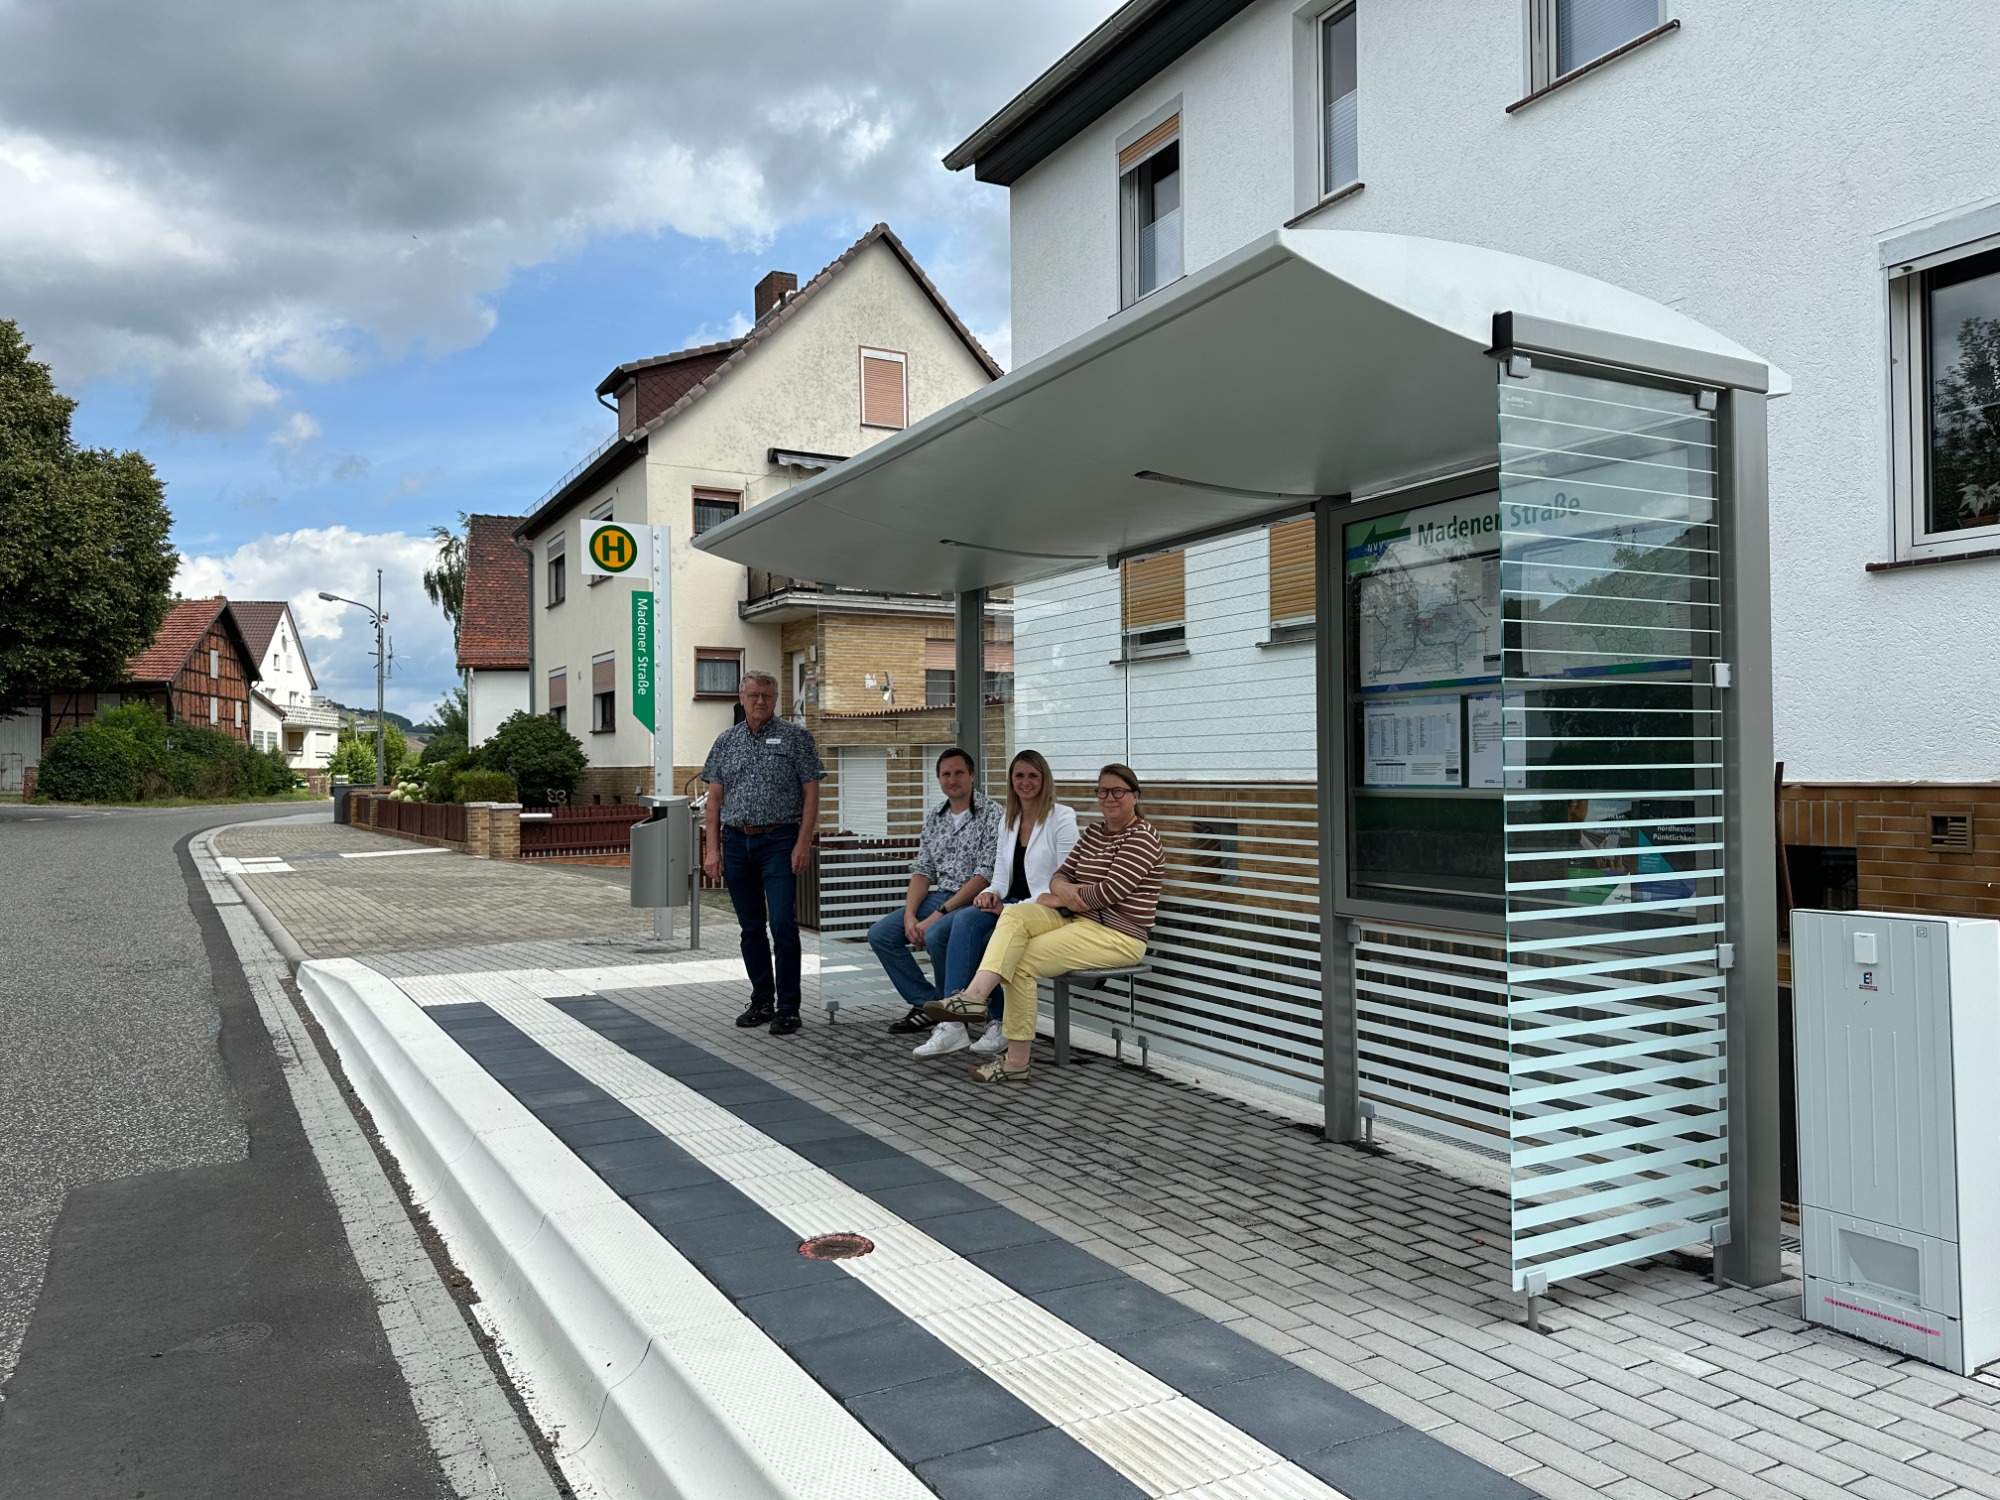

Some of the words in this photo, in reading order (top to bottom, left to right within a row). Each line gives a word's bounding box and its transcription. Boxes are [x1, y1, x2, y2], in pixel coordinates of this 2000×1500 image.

[1418, 512, 1501, 547] Madener
[1511, 492, 1582, 528] Straße
[602, 535, 625, 563] H
[637, 598, 648, 653] Madener
[637, 656, 650, 696] Straße
